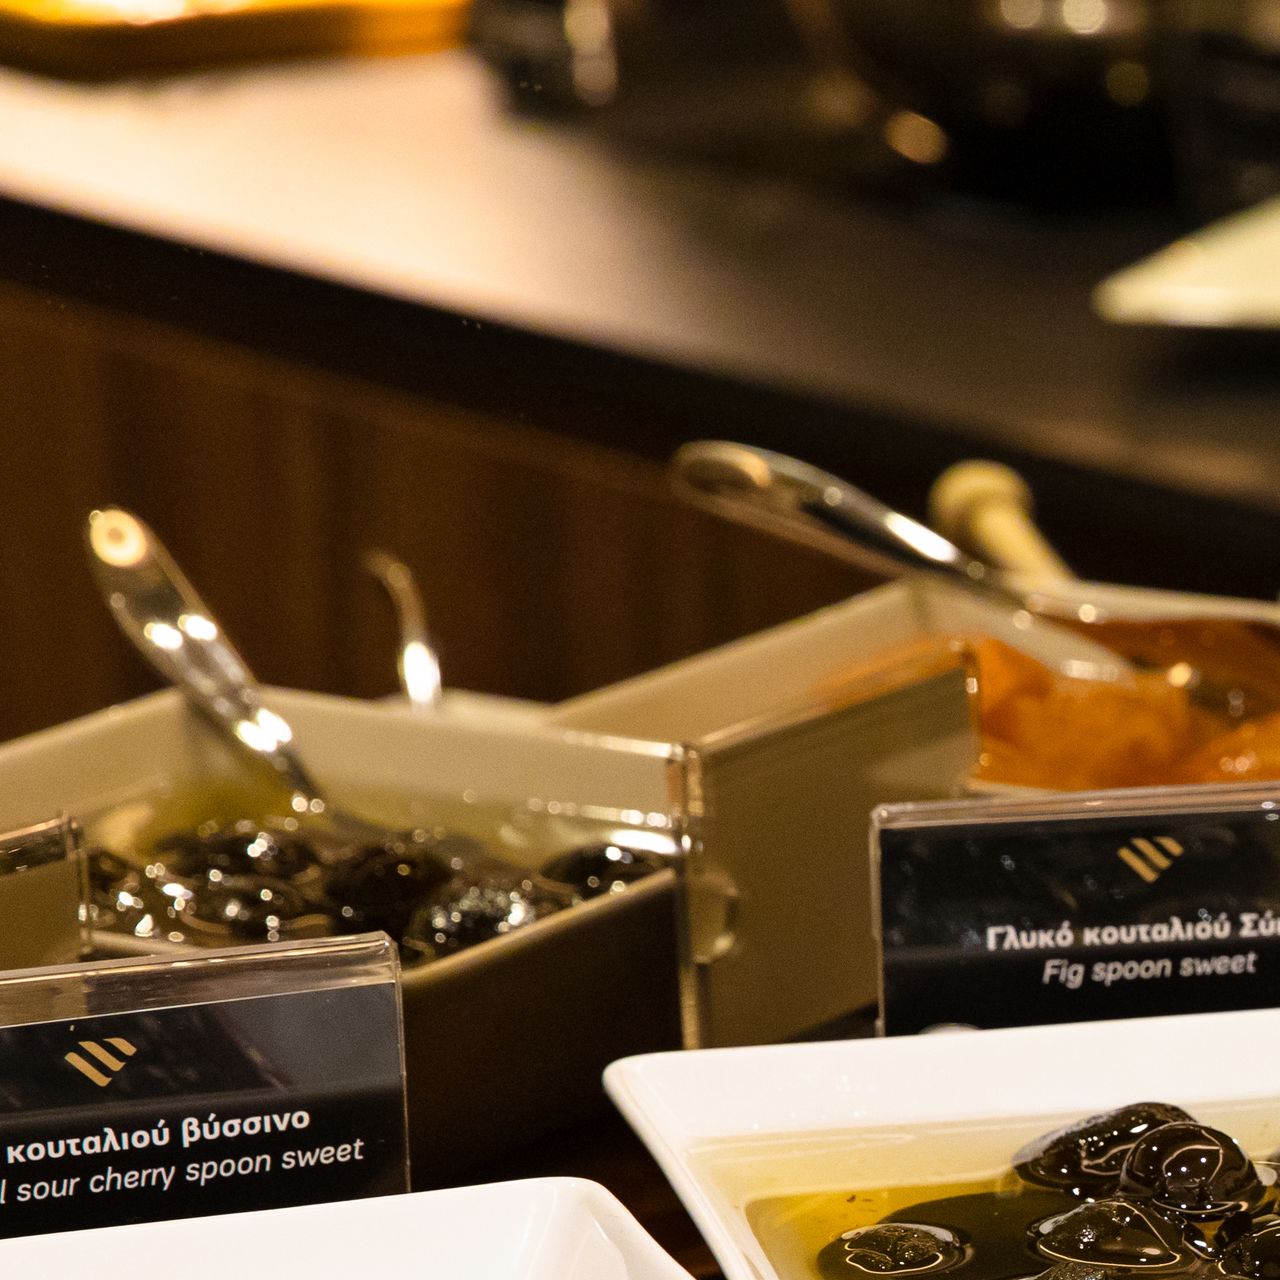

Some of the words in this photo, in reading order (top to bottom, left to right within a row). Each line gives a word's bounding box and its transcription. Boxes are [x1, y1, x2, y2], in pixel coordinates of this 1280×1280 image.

[986, 920, 1074, 951] Γλυκό
[1083, 913, 1231, 946] κουταλιού
[1042, 958, 1084, 989] Fig
[1092, 957, 1171, 986] spoon
[1179, 951, 1258, 977] sweet
[7, 1119, 170, 1164] κουταλιού
[181, 1109, 310, 1148] βύσσινο
[16, 1175, 80, 1202] sour
[89, 1162, 176, 1192] cherry
[185, 1153, 271, 1186] spoon
[281, 1137, 365, 1169] sweet
